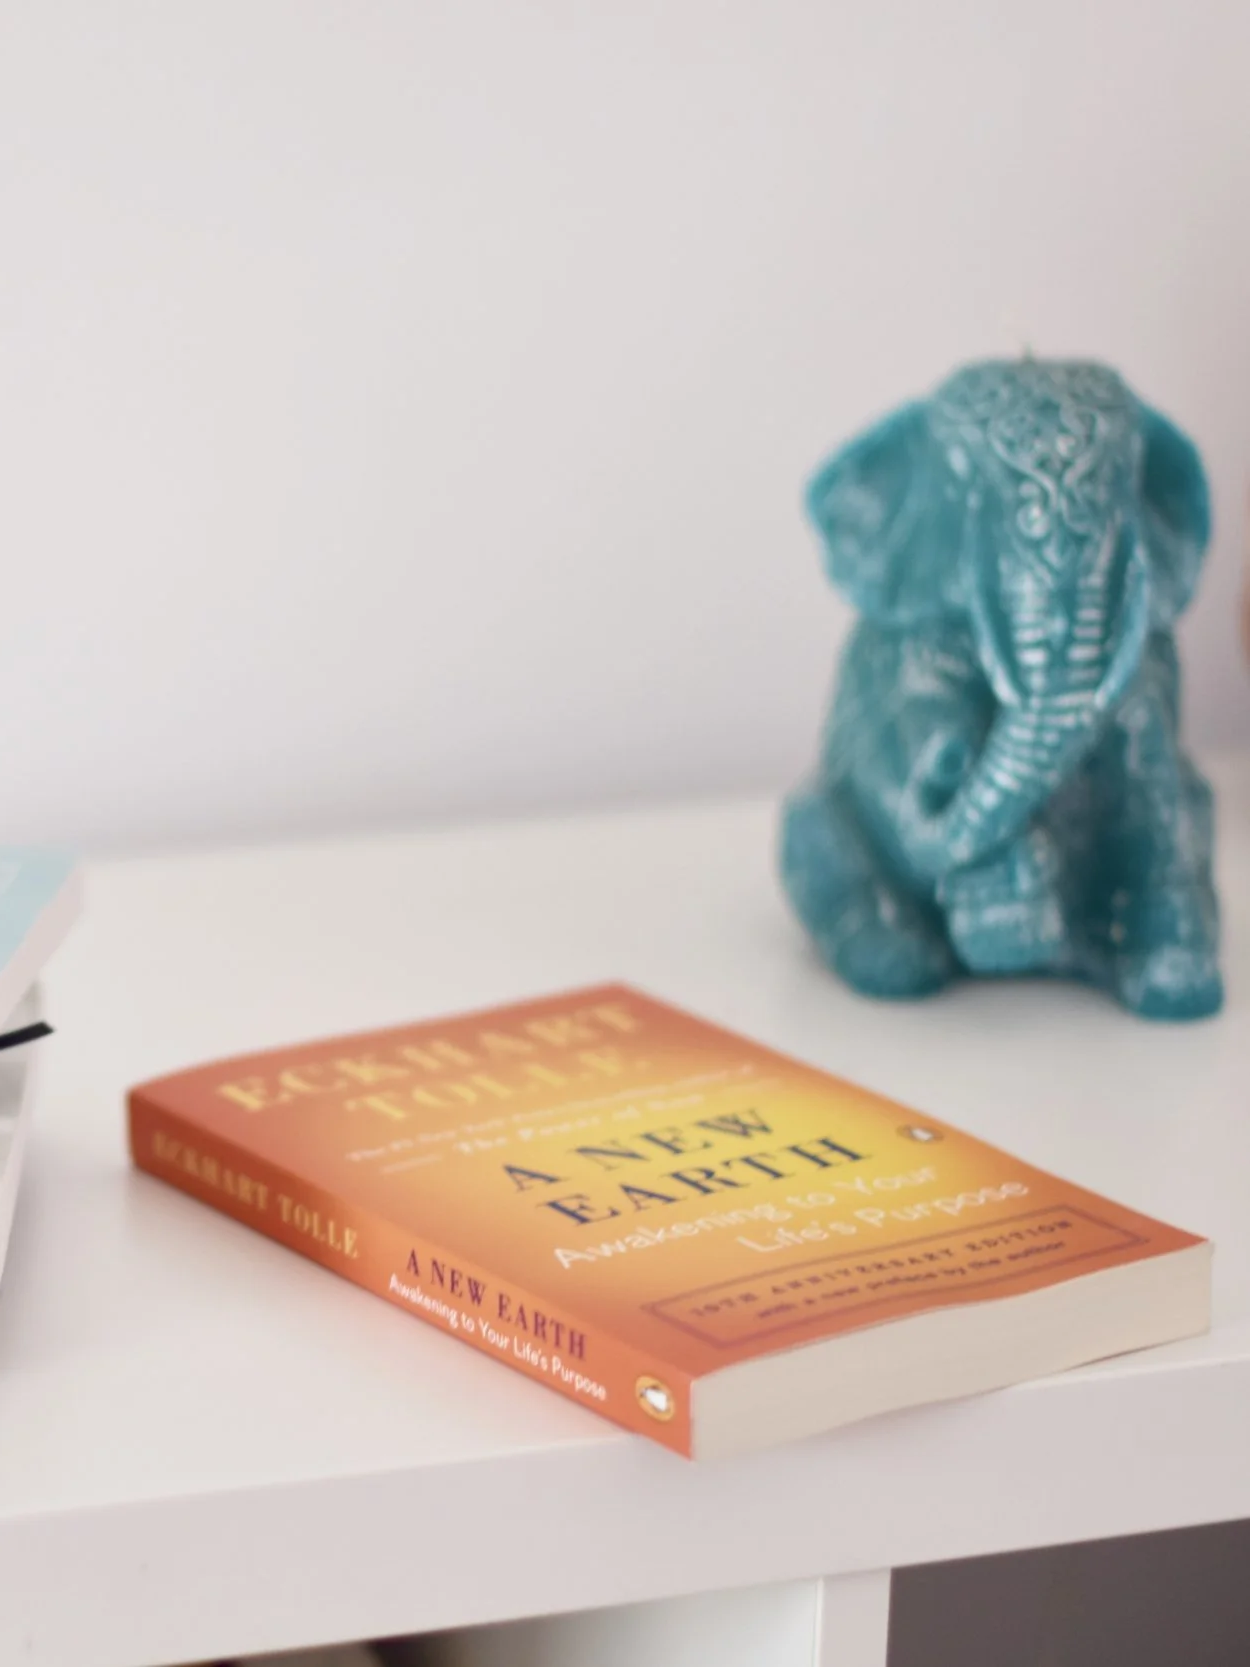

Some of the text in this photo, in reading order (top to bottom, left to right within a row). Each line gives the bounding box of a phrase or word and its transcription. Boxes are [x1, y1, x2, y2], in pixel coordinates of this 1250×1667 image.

[501, 1108, 774, 1192] A NEW
[543, 1137, 866, 1227] EARTH
[277, 1194, 359, 1260] TOLLE
[552, 1165, 938, 1269] Awakening to Your
[735, 1181, 1030, 1254] Life's Purpose
[388, 1272, 608, 1402] Awakening to Your Life's Purpose
[406, 1248, 587, 1361] A NEW EARTH
